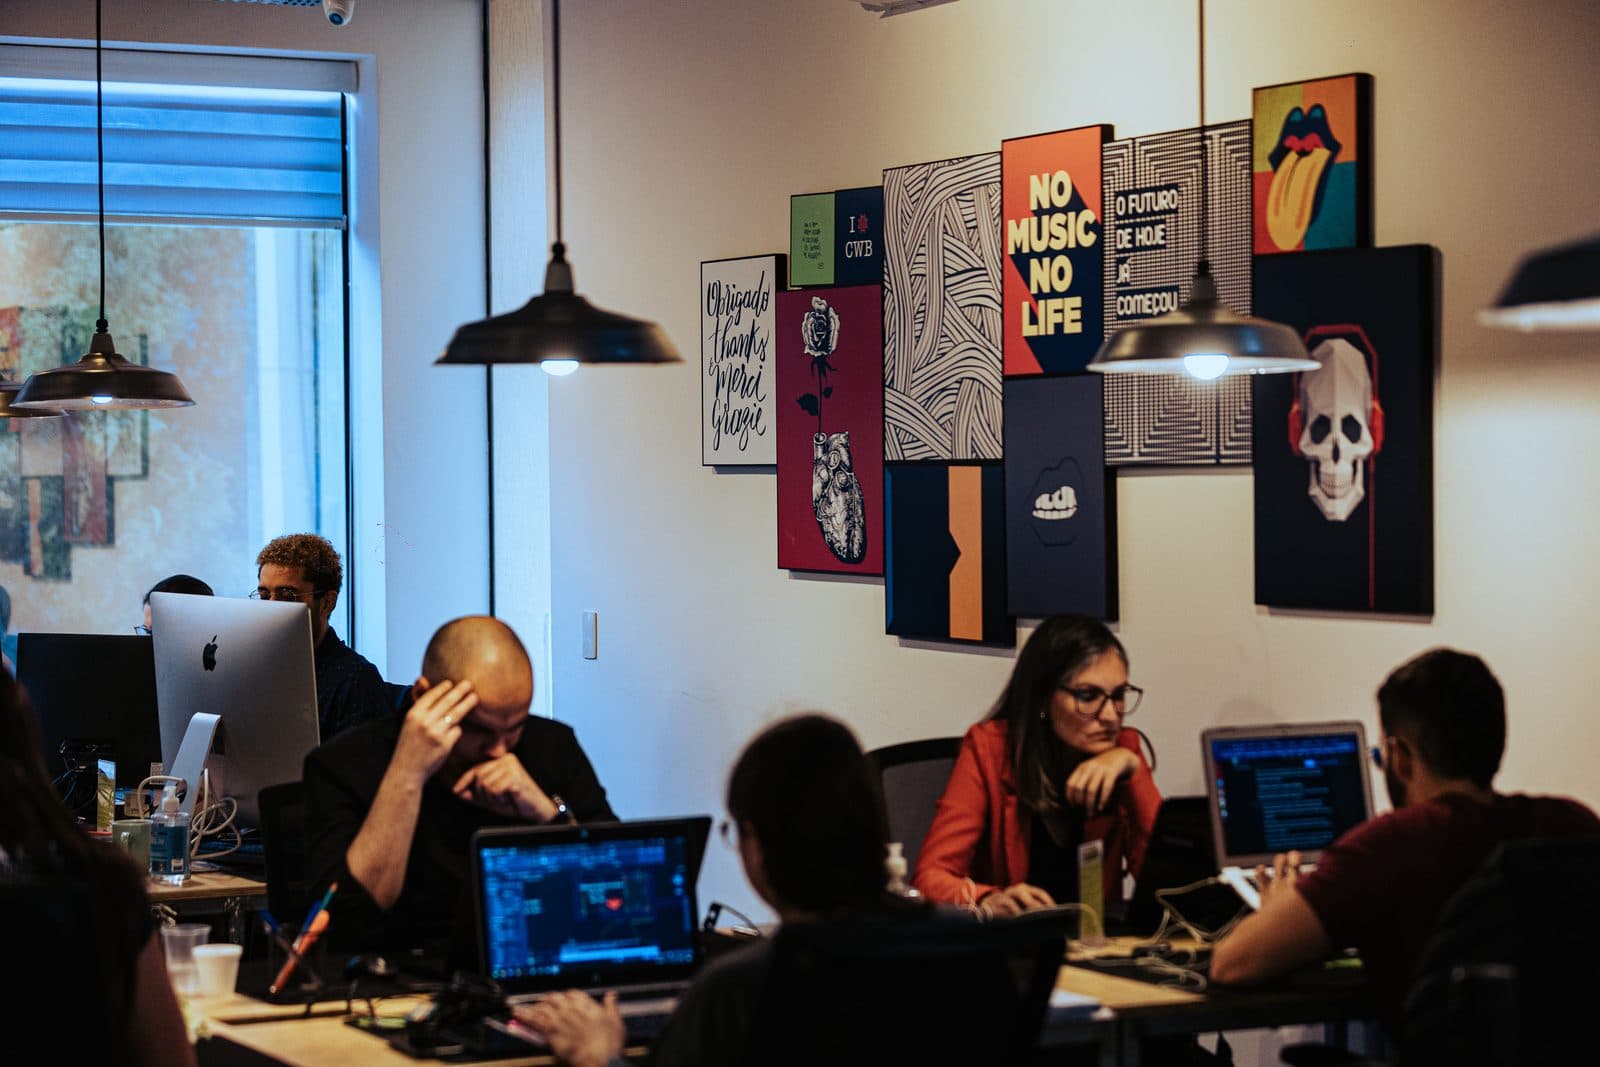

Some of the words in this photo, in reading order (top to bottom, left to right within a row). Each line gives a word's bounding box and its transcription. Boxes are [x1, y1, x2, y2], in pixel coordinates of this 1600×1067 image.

[1029, 170, 1073, 211] NO
[1115, 196, 1126, 215] O
[1127, 189, 1178, 214] FUTURO
[849, 216, 856, 233] I
[1007, 208, 1097, 255] MUSIC
[1116, 227, 1133, 250] DE
[1135, 223, 1166, 248] HOJE
[845, 239, 873, 259] CWB
[1029, 254, 1073, 295] NO
[1116, 257, 1132, 284] JÁ
[707, 270, 770, 326] Obrigado
[1116, 291, 1178, 317] COMEÇOU
[1021, 296, 1082, 337] LIFE
[709, 357, 766, 412] Merci
